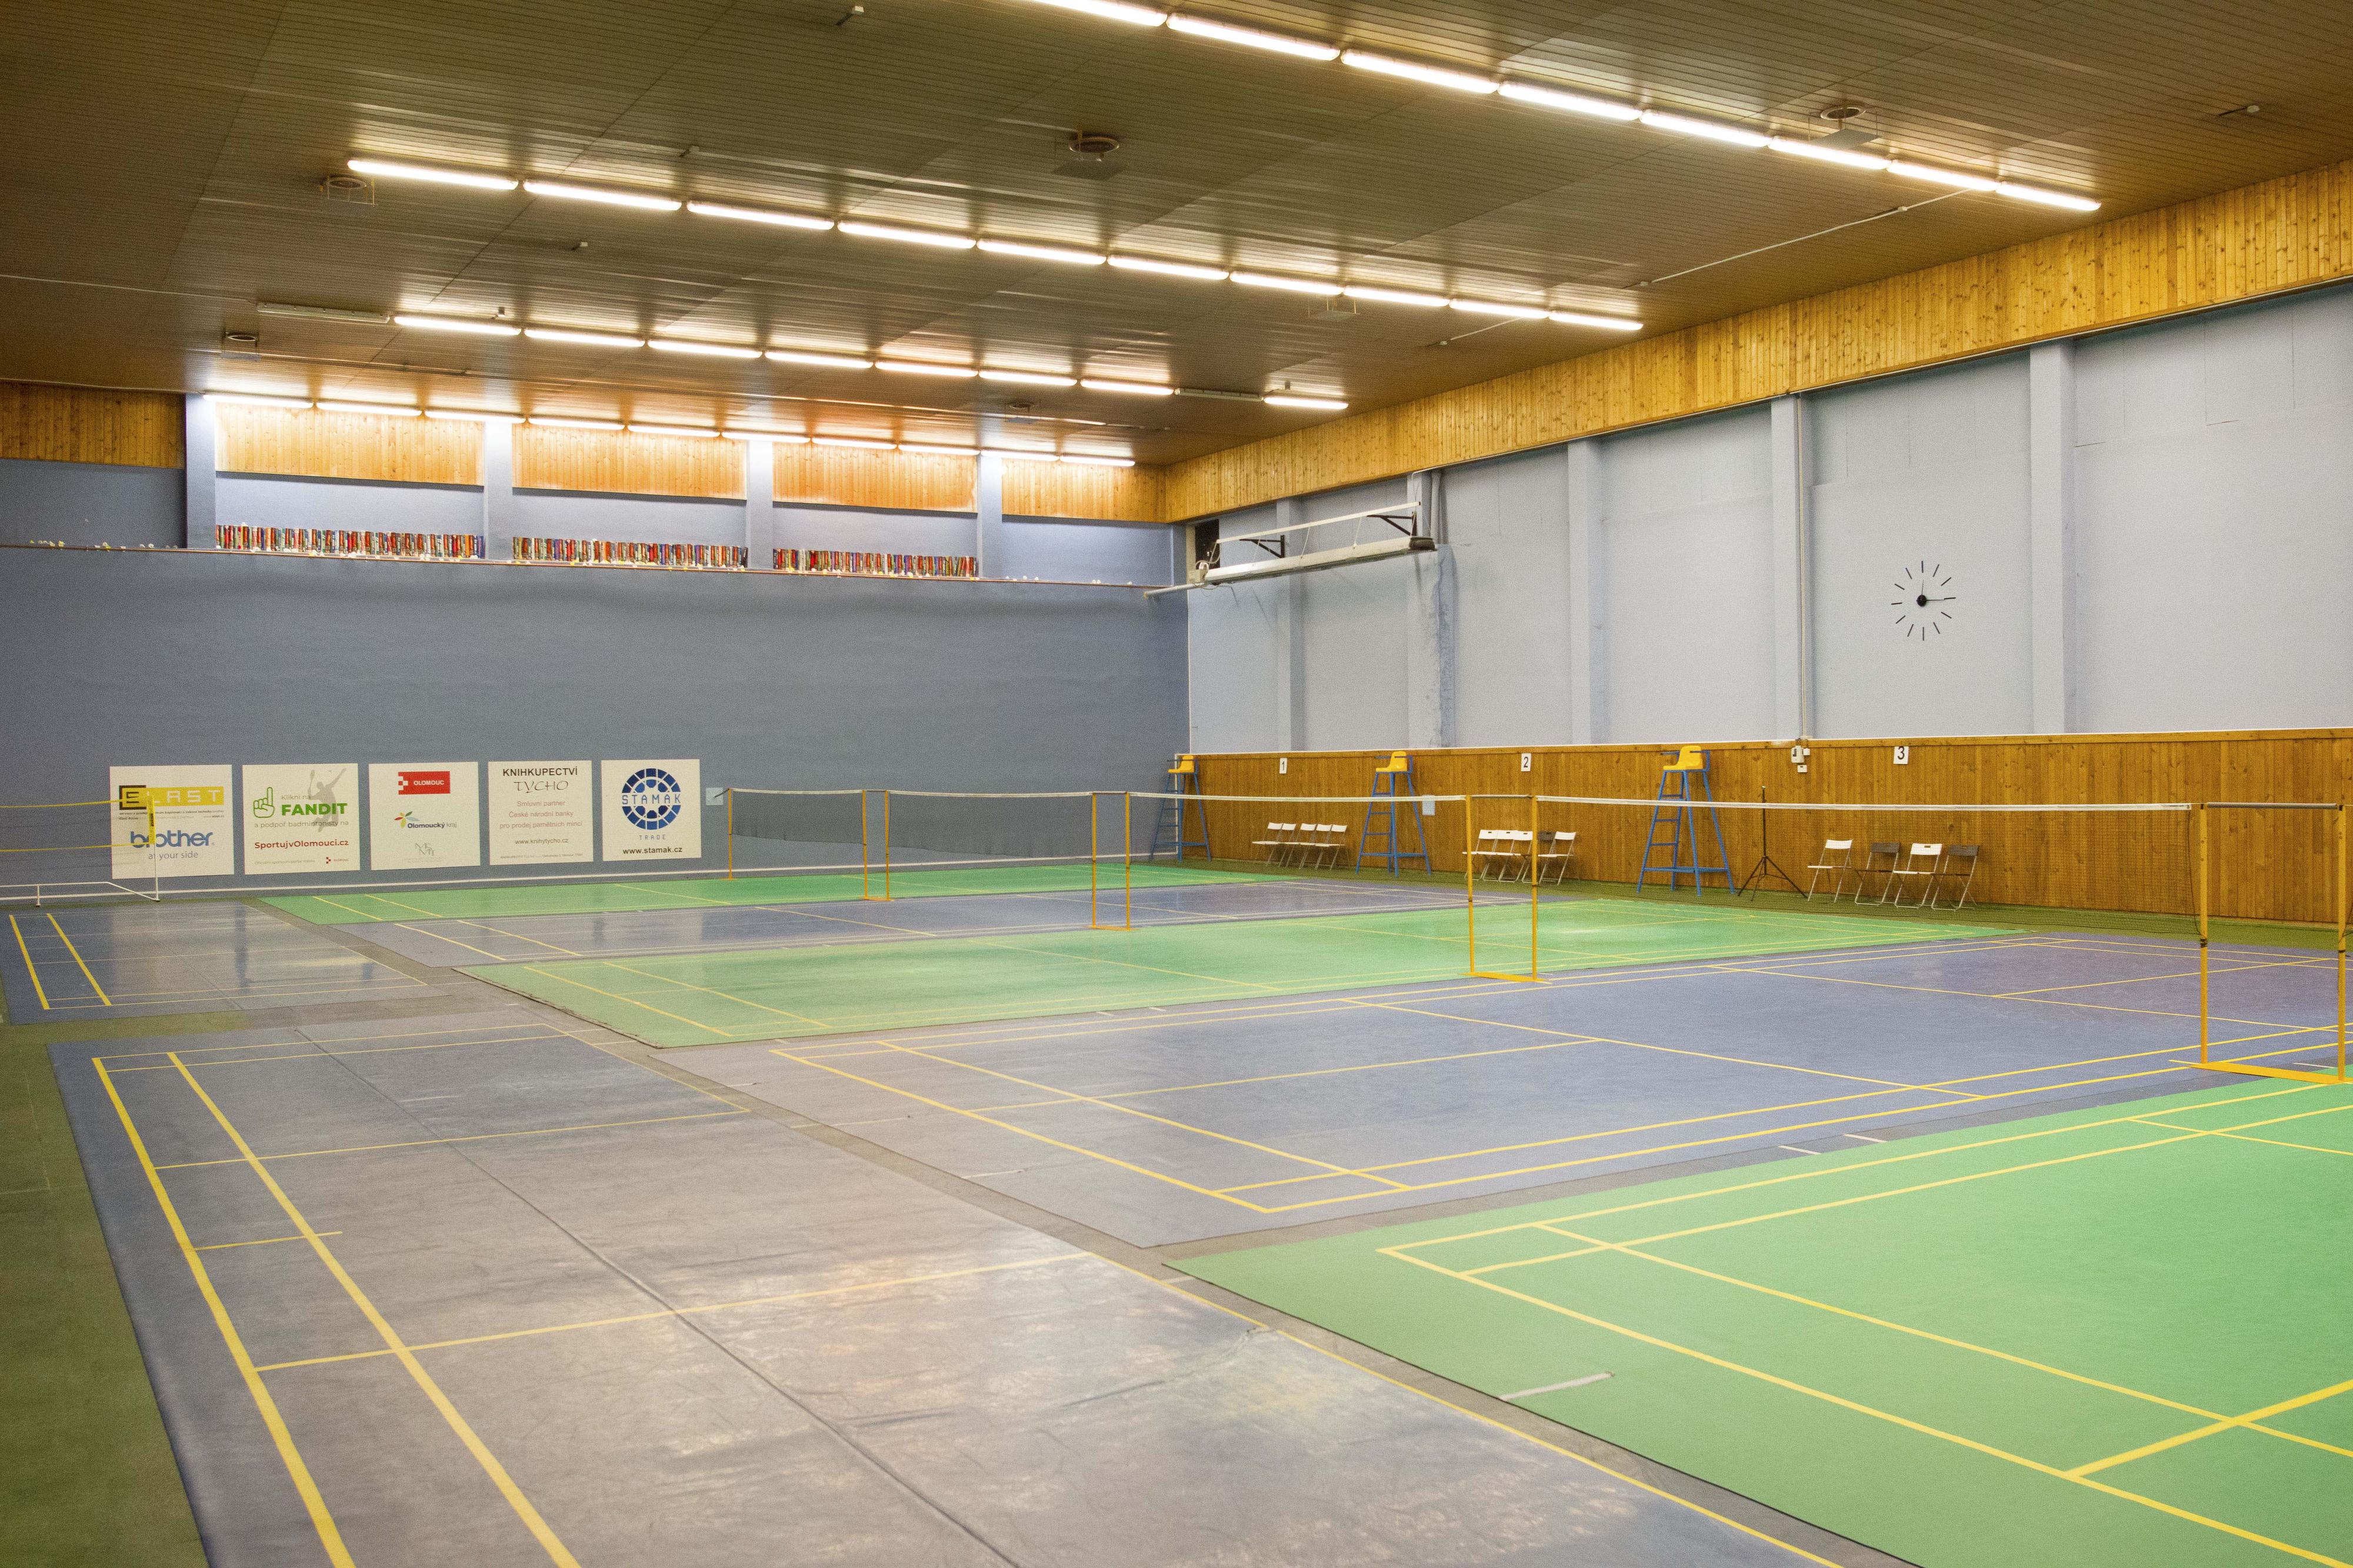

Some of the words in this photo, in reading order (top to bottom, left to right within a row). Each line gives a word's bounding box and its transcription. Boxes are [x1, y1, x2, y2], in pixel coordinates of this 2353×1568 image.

[1897, 746, 1905, 760] 3
[1282, 760, 1285, 771] 1
[1524, 756, 1529, 768] 2
[503, 766, 578, 776] KNIHKUPECTVÍ
[514, 780, 569, 793] TYCHO
[622, 794, 681, 805] STAMAK
[281, 803, 348, 816] FANDIT
[255, 839, 349, 849] SportujvOlomouci.cz
[159, 852, 178, 861] your
[181, 850, 199, 859] side
